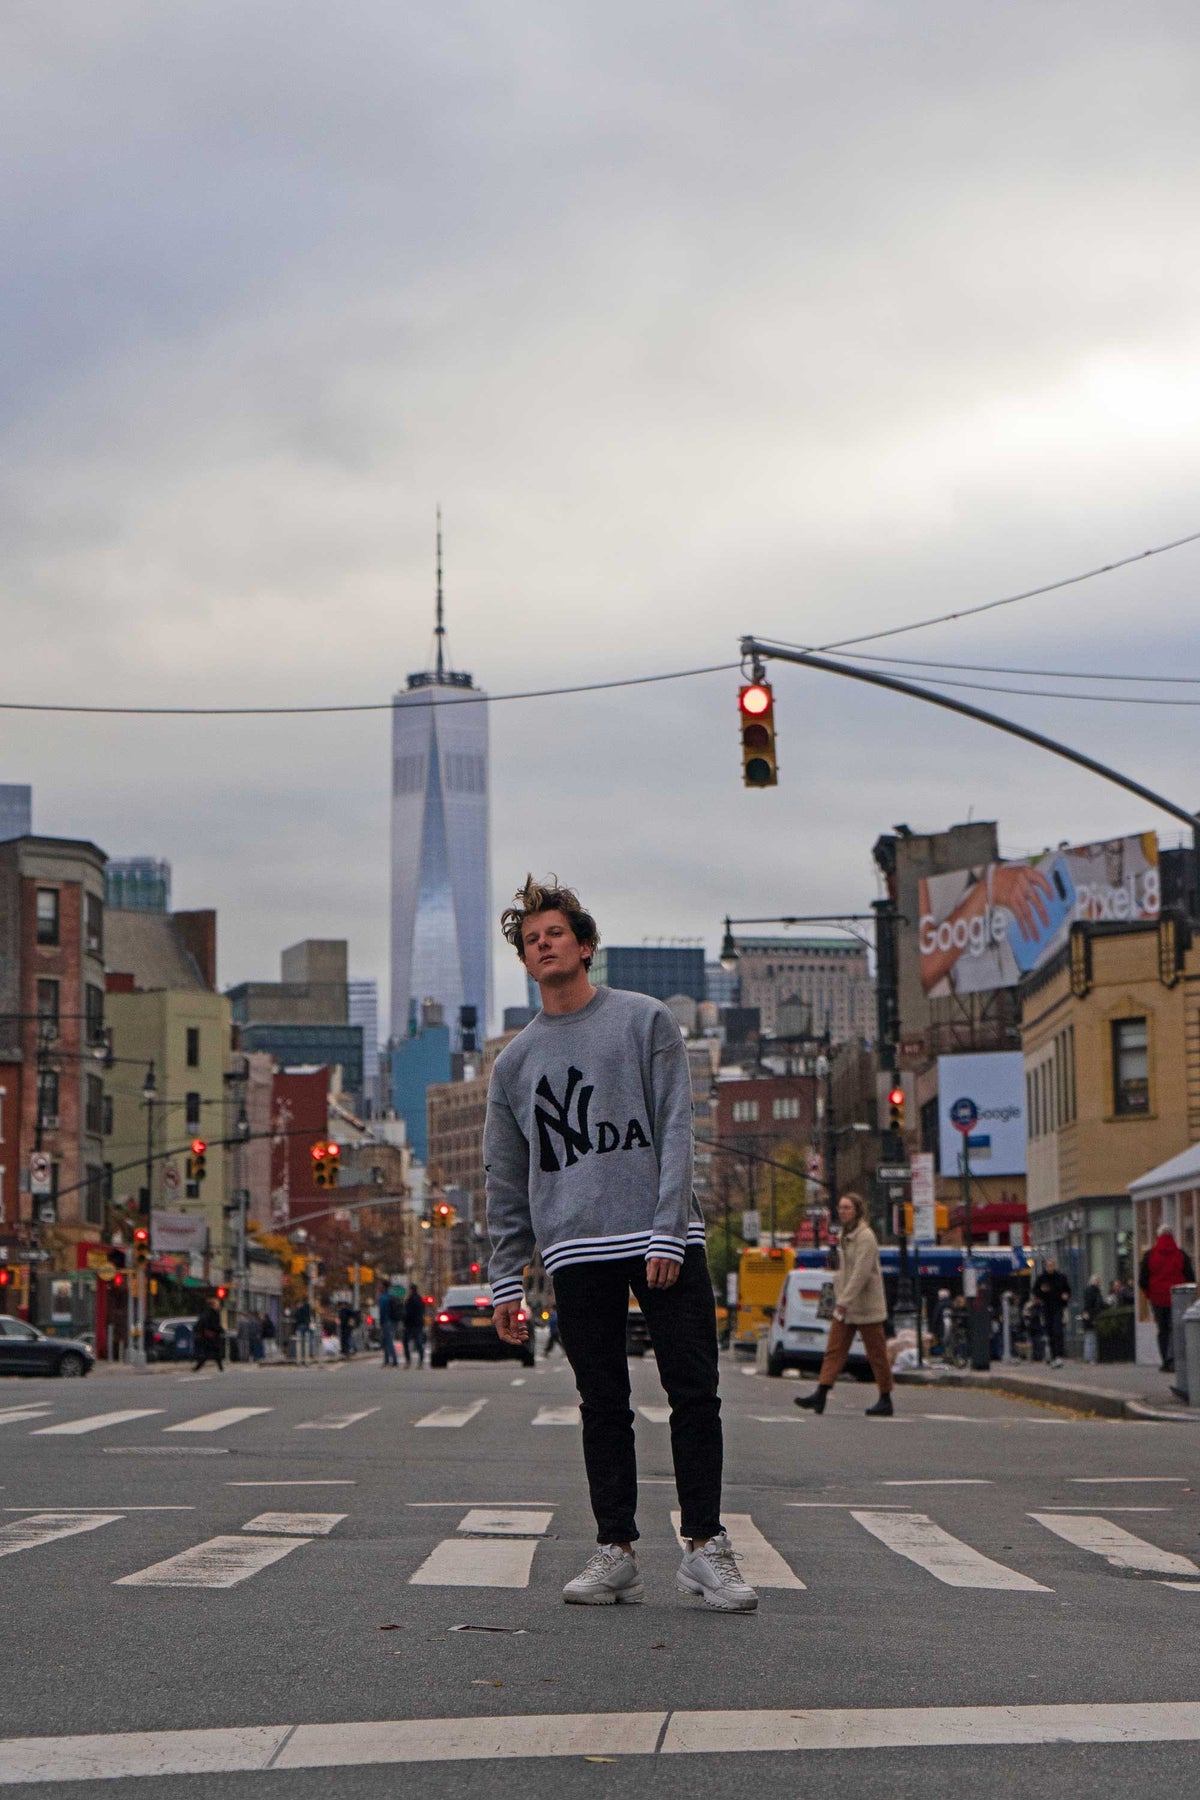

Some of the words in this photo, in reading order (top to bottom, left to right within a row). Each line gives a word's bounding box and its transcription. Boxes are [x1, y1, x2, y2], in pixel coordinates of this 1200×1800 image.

[919, 904, 1008, 957] Google
[1075, 873, 1135, 920] Pixel
[1143, 869, 1161, 915] 8
